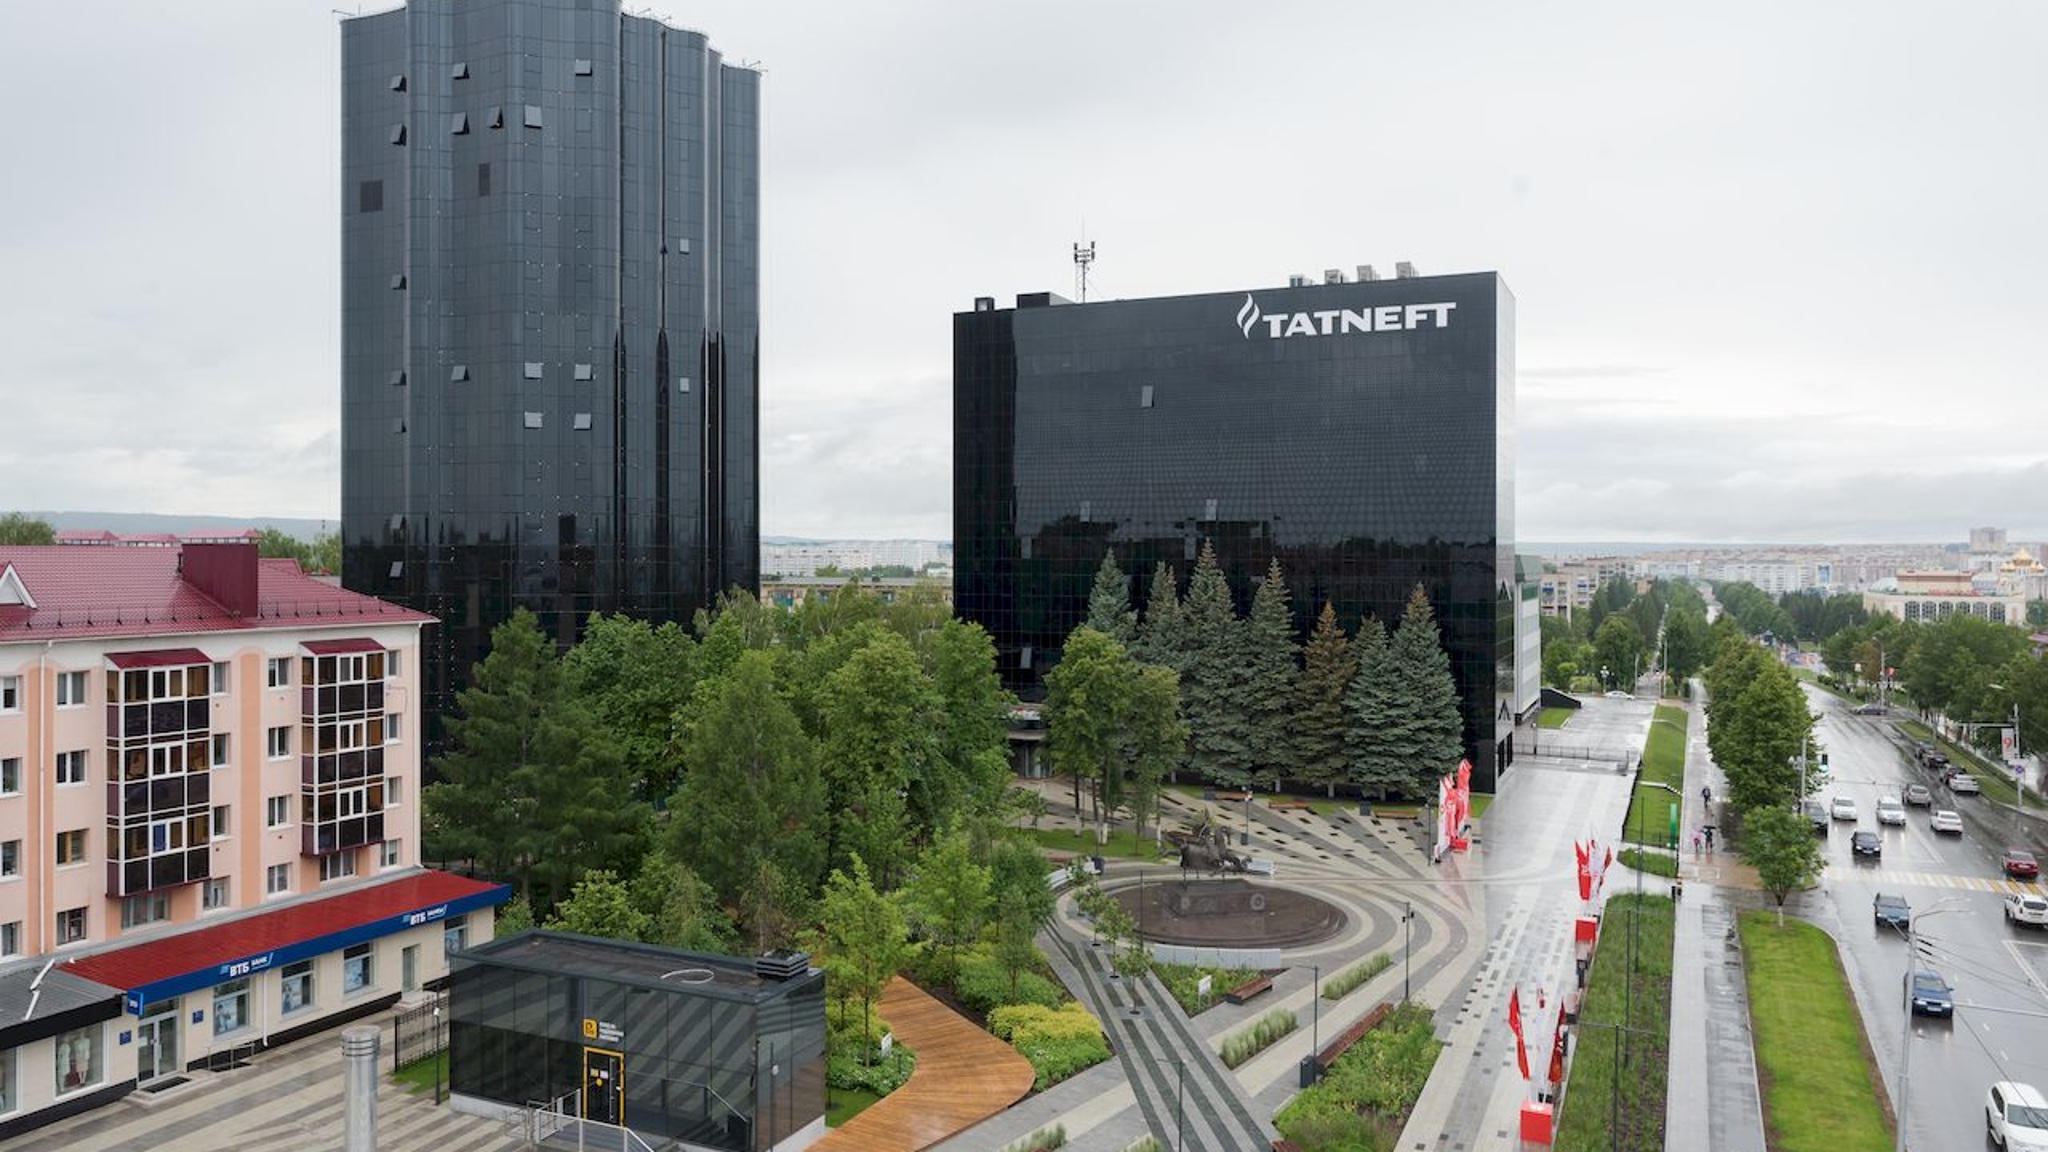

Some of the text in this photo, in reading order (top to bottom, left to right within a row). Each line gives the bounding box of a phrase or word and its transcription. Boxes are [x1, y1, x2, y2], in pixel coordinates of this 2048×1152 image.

[1262, 302, 1457, 339] TATNEFT
[410, 911, 426, 925] ВТБ
[230, 961, 250, 977] ВТБ
